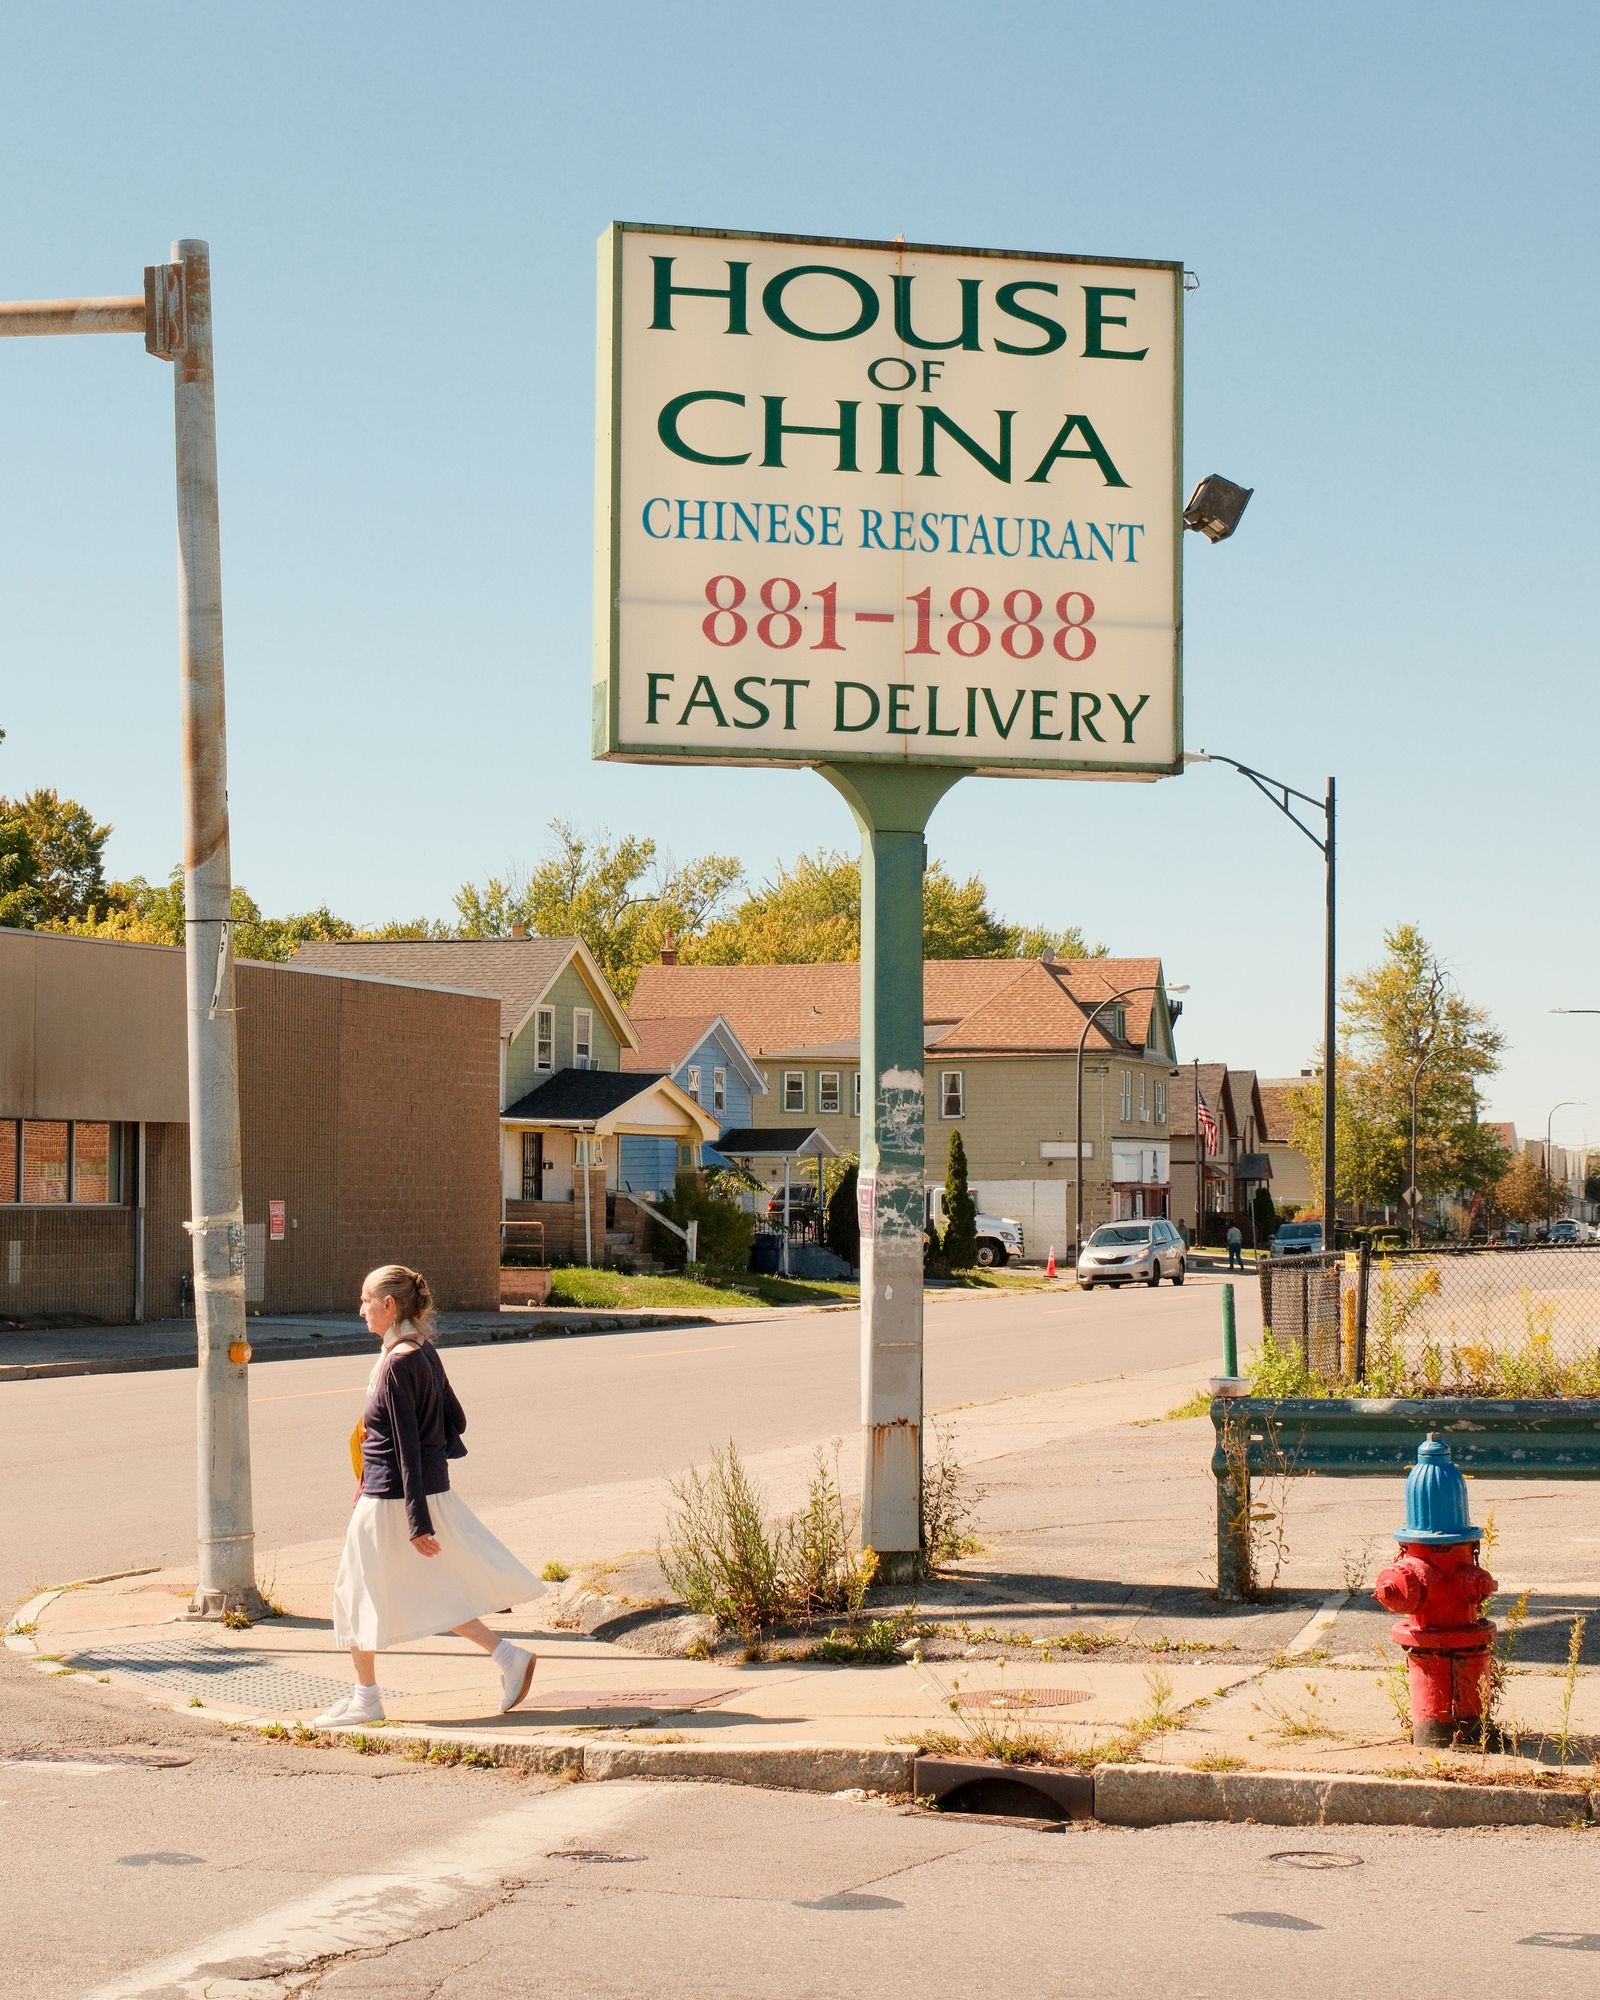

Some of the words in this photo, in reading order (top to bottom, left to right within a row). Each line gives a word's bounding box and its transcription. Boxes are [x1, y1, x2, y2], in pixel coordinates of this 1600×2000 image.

[647, 256, 1150, 361] HOUSE
[867, 357, 945, 392] OF
[657, 390, 1133, 489] CHINA
[641, 497, 844, 547] CHINESE
[858, 509, 1145, 563] RESTAURANT
[701, 574, 1097, 662] 881-1888
[645, 672, 810, 731] FAST
[833, 680, 1150, 744] DELIVERY
